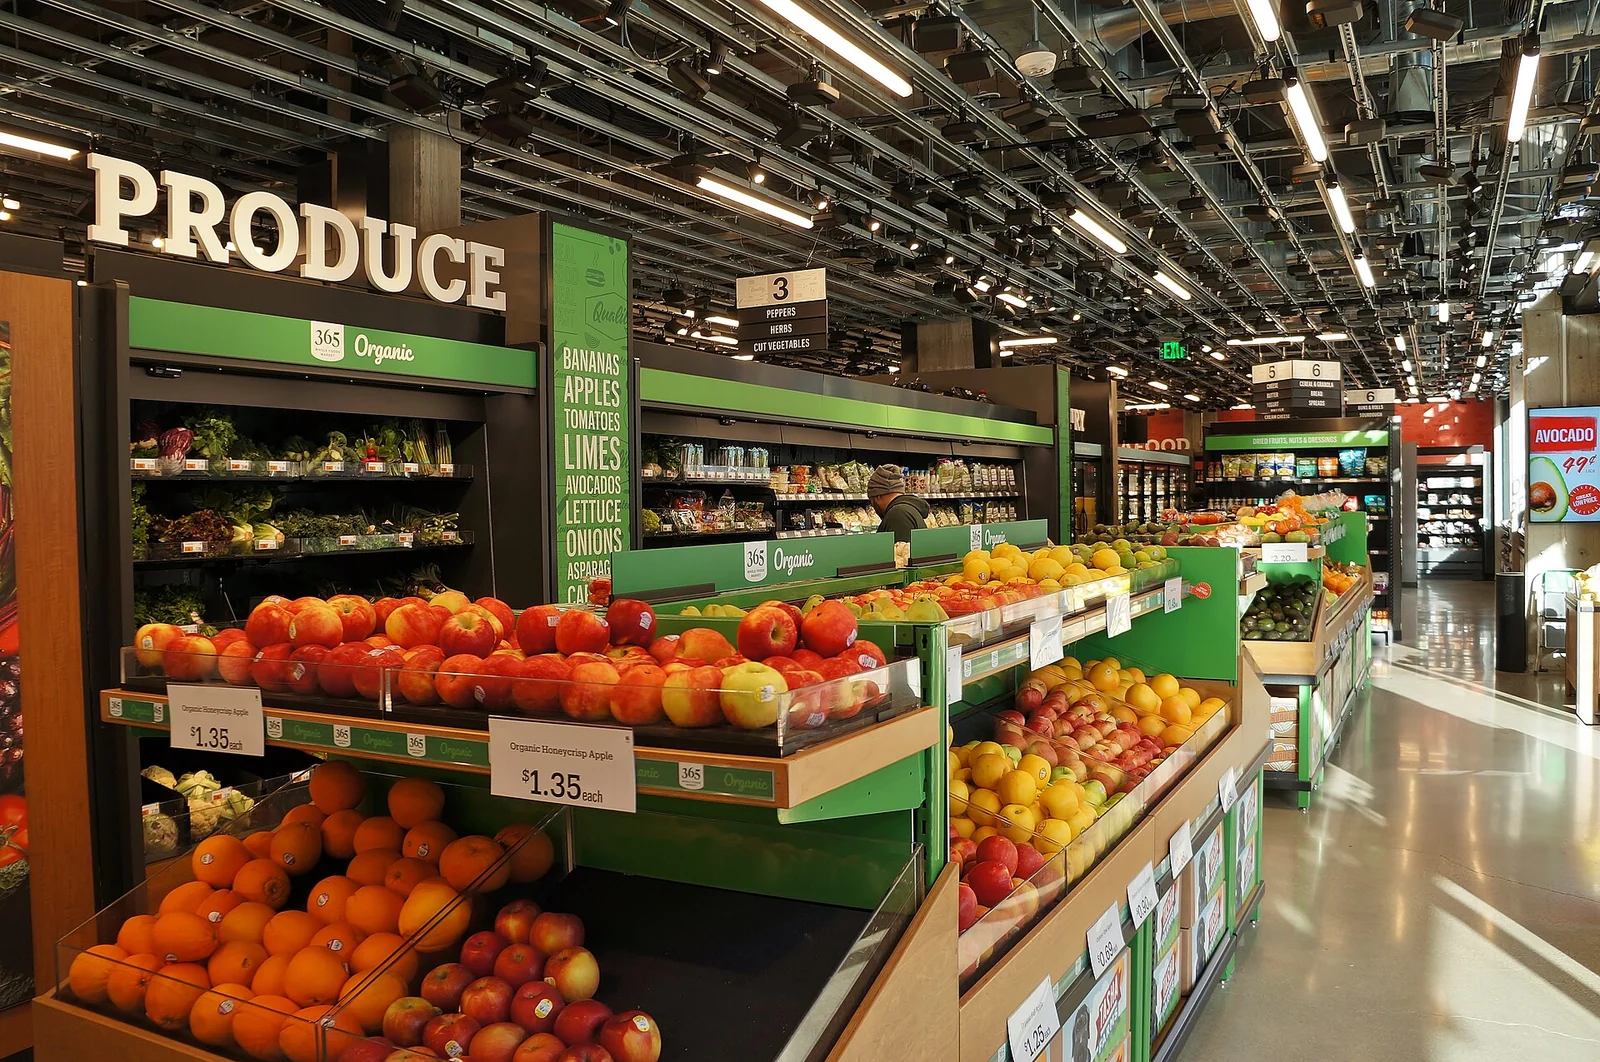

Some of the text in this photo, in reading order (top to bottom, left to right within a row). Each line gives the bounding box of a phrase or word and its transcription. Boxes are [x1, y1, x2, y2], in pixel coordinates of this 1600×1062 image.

[87, 153, 506, 311] PRODUCE
[773, 276, 789, 300] 3
[767, 307, 796, 319] PEPPERS
[770, 324, 793, 335] HERBS
[315, 329, 415, 365] 365 Organic
[753, 338, 810, 352] CUT VEGETABLES
[563, 346, 620, 376] BANANAS
[1268, 365, 1276, 379] 5
[1312, 363, 1320, 377] 6
[563, 375, 620, 408] APPLES
[1366, 391, 1375, 402] 6
[563, 408, 621, 432] TOMATOES
[1535, 428, 1594, 443] AVOCADO
[564, 433, 621, 471] LIMES
[565, 475, 621, 495] AVOCADOS
[565, 500, 622, 525] LETTUCE
[566, 527, 622, 557] ONIONS
[567, 559, 611, 581] ASPARAG
[747, 547, 814, 576] 365 Organic
[182, 705, 249, 716] Organic Honeycrisp Apple
[269, 721, 281, 730] 365
[335, 729, 349, 739] 365
[190, 726, 243, 751] $1.35 each
[409, 738, 473, 759] 365 Organic
[509, 742, 613, 761] Organic Honeycrisp Apple
[522, 768, 603, 803] $1.35 each
[681, 767, 769, 792] 365 Organic
[1097, 941, 1114, 967] $0.69
[1023, 1024, 1045, 1057] $1.25
